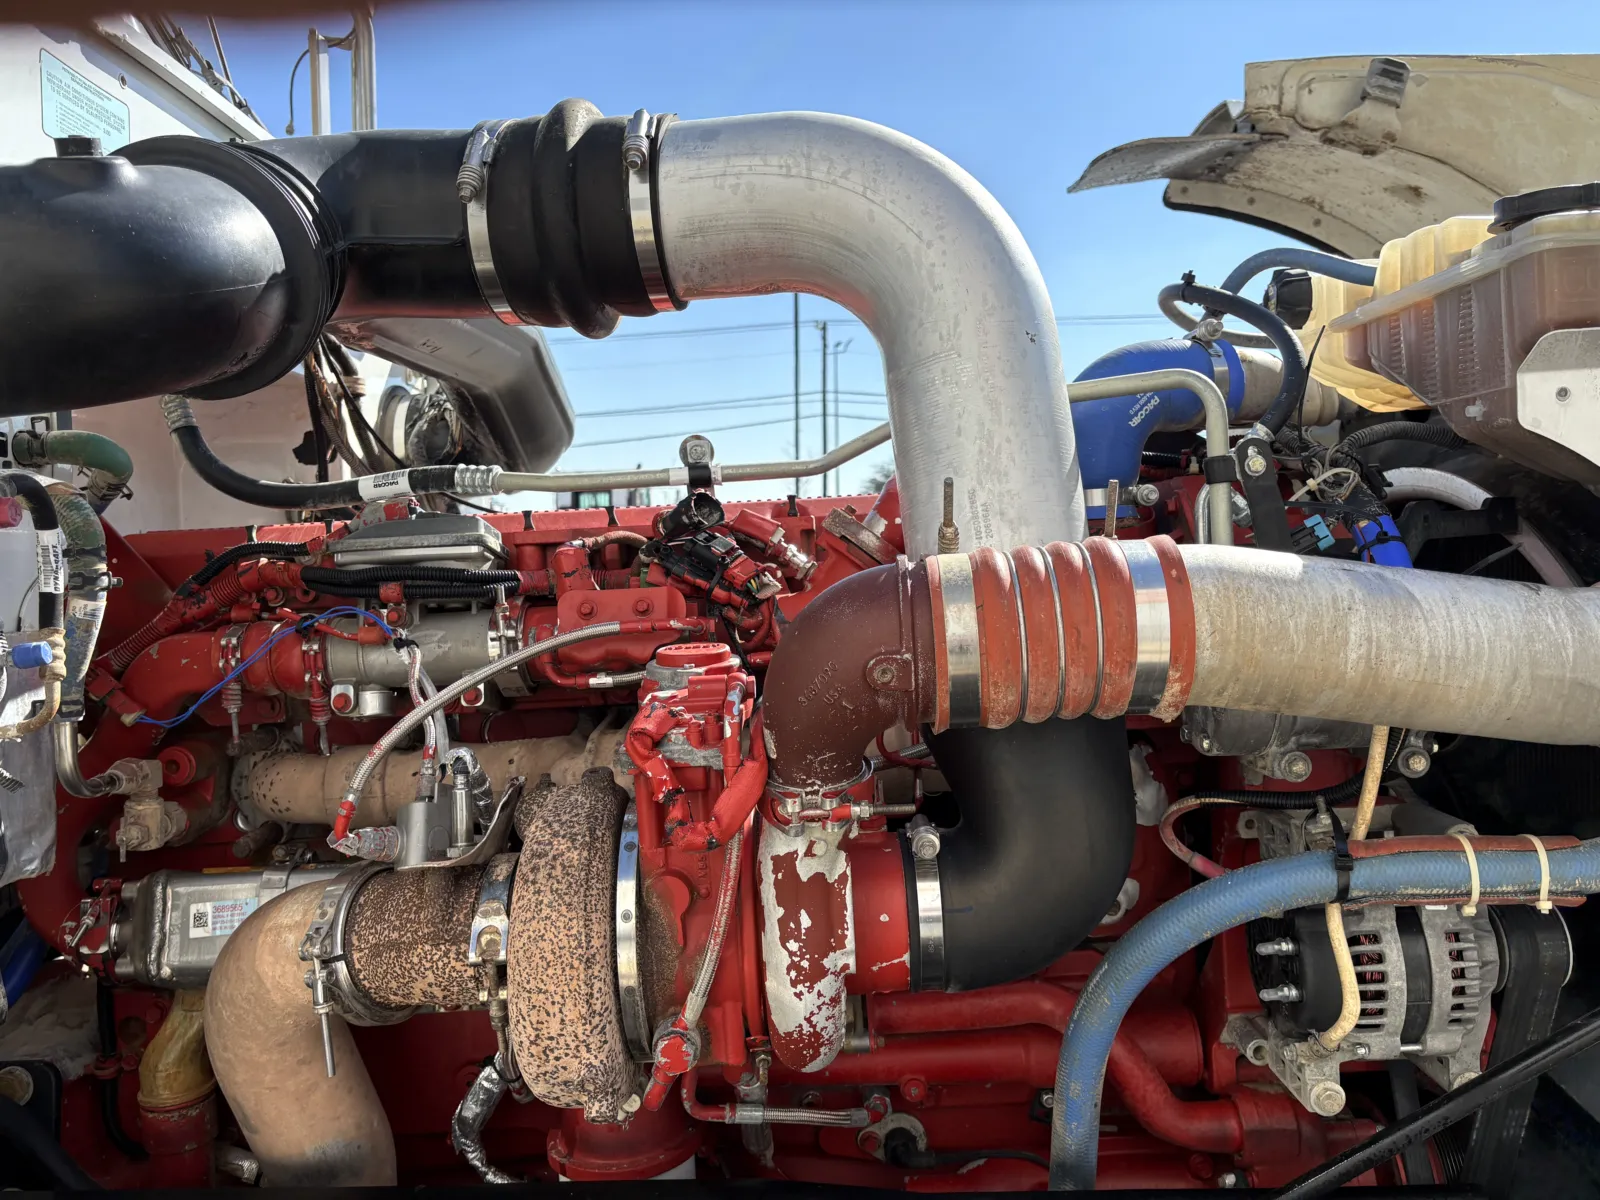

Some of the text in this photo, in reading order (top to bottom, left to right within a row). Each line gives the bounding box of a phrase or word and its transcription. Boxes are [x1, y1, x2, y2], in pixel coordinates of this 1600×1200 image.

[1128, 395, 1160, 427] PACCAR
[373, 480, 399, 488] PACCAR
[798, 660, 838, 706] 3687090
[212, 904, 243, 913] 3689565
